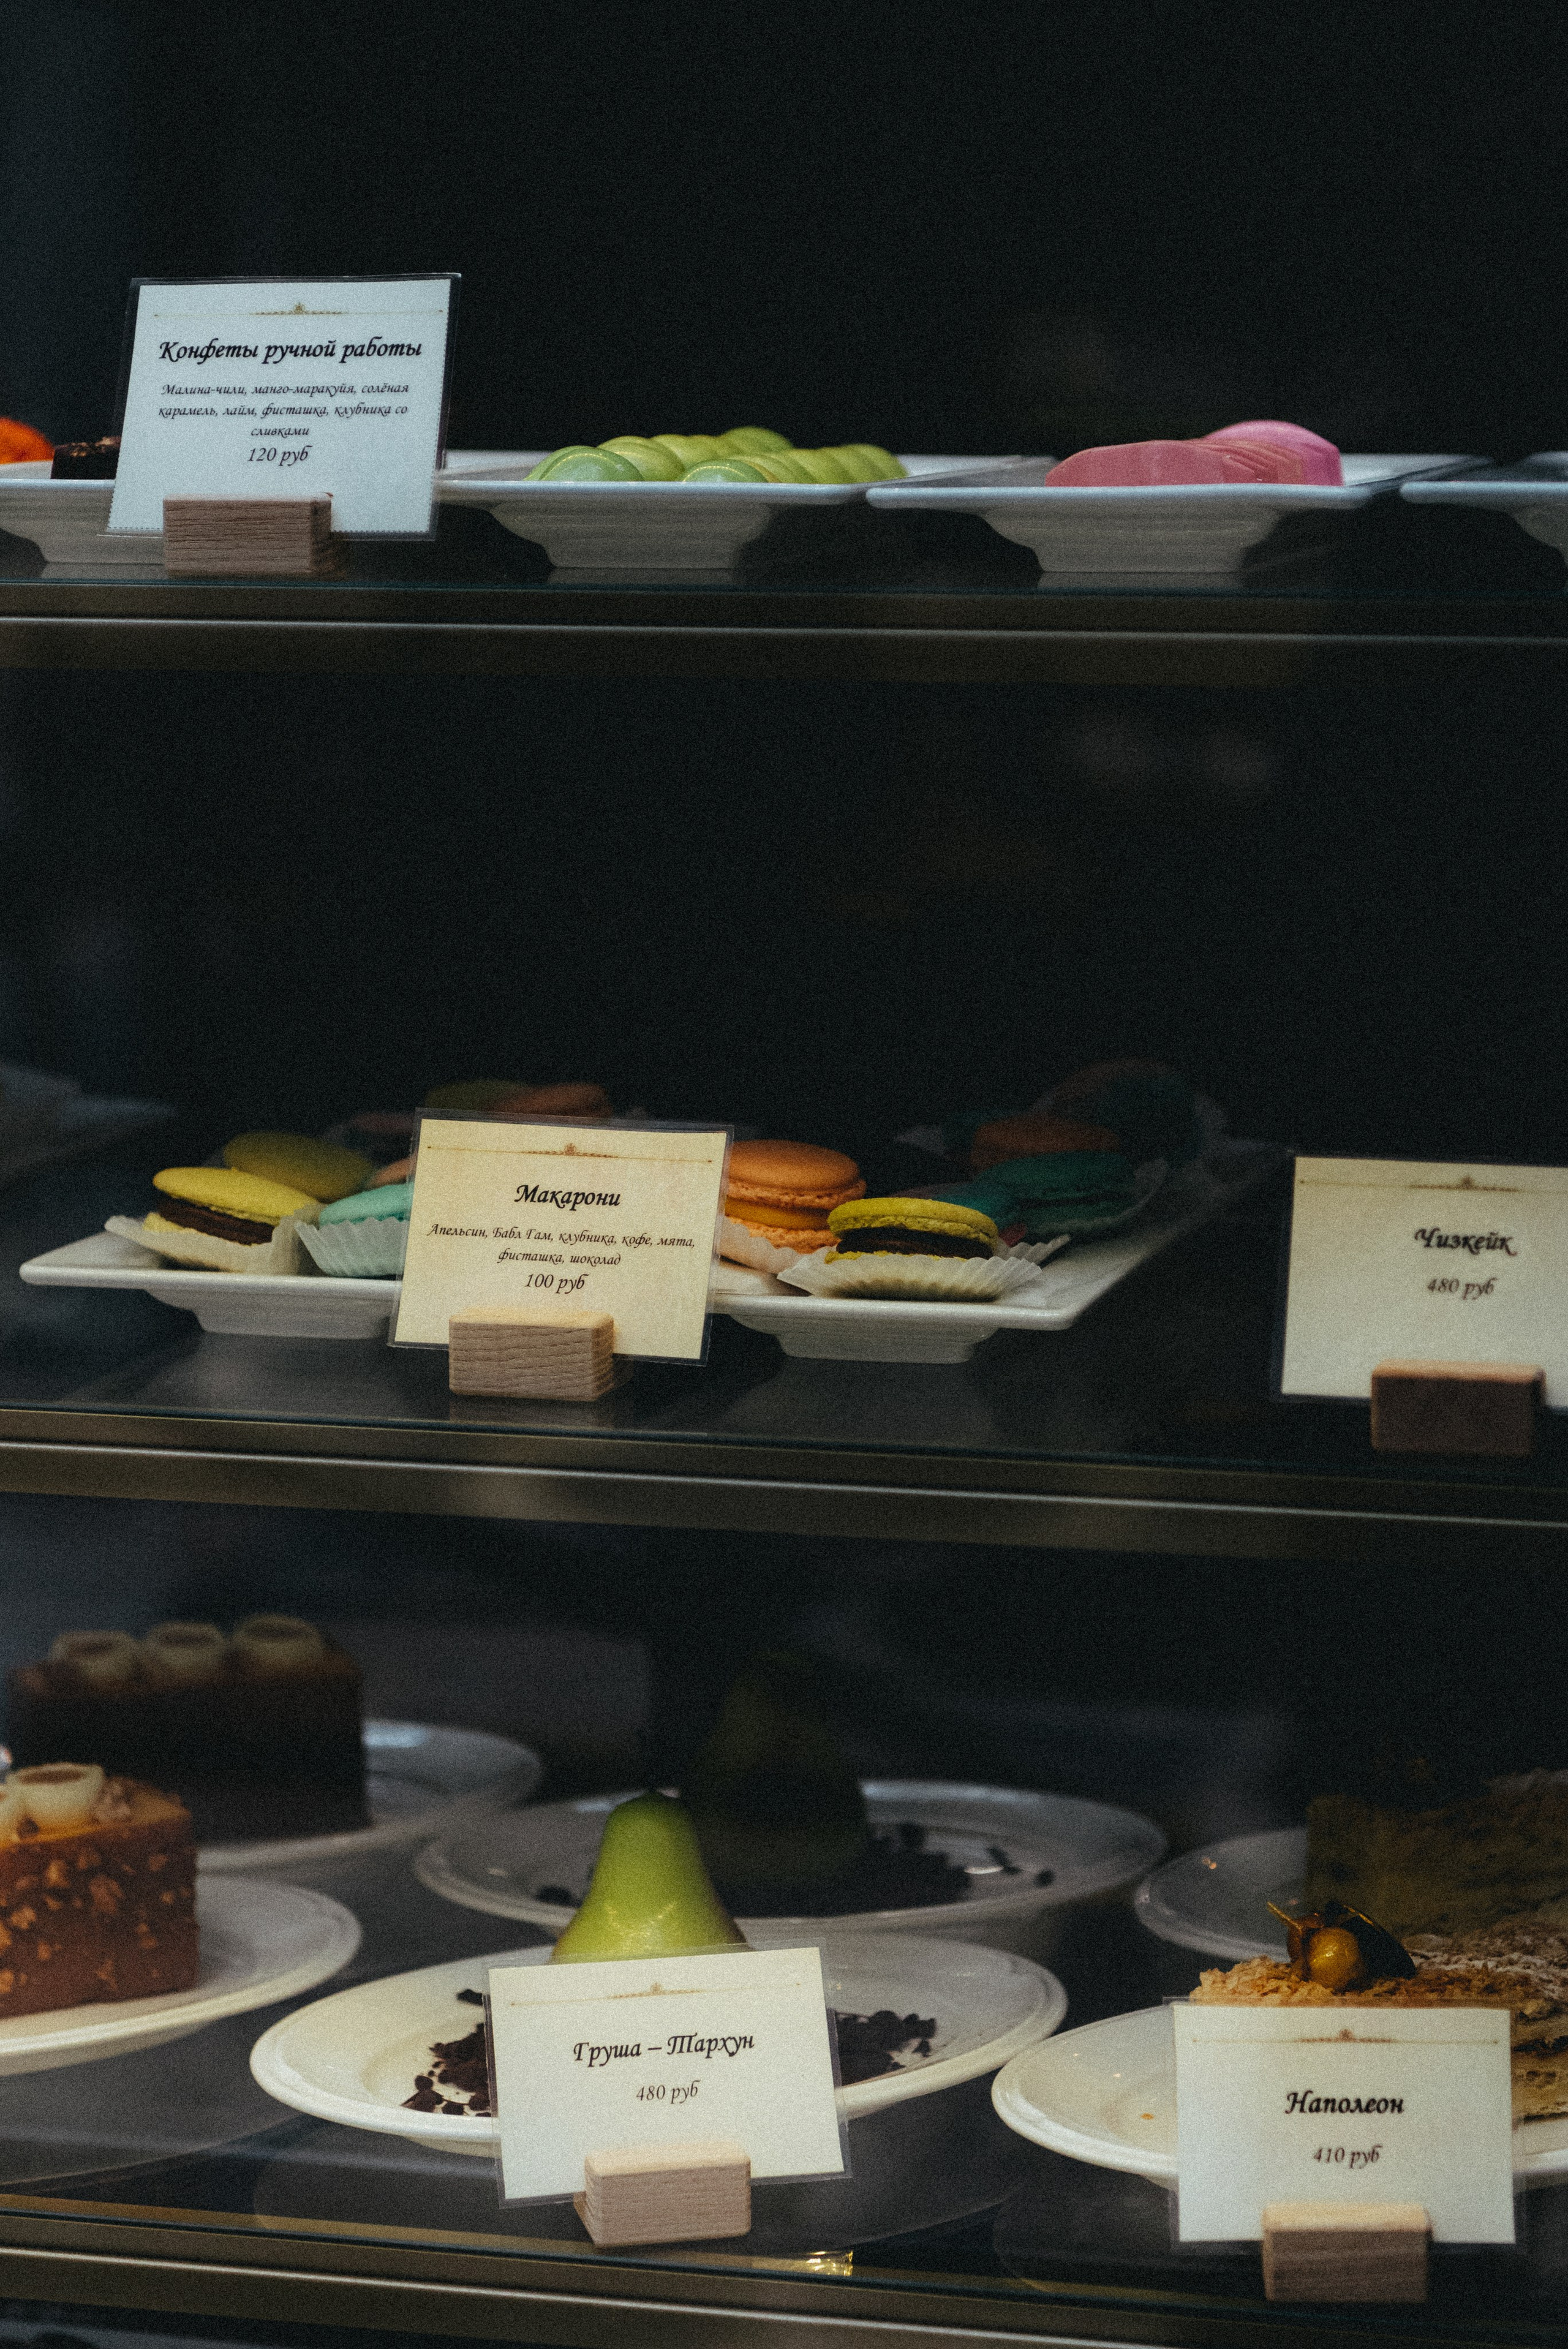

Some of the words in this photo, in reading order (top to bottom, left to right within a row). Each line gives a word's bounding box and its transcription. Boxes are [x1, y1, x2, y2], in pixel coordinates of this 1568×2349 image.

[159, 338, 258, 365] Конфеты
[262, 339, 336, 364] ручной
[339, 336, 422, 364] работы
[161, 383, 247, 396] Малина-чили,
[251, 383, 357, 398] манго-маракуйя,
[361, 383, 409, 394] солёная
[158, 405, 218, 420] карамель,
[223, 404, 258, 417] лайм,
[261, 403, 330, 419] фисташка,
[334, 402, 391, 419] клубника
[394, 406, 408, 415] со
[251, 426, 309, 438] сливками
[247, 446, 277, 462] 120
[279, 445, 313, 467] руб
[514, 1184, 621, 1211] Макарони
[427, 1223, 488, 1239] Апельсин,
[492, 1226, 522, 1239] Бабл
[526, 1228, 554, 1242] Гам,
[559, 1230, 617, 1245] клубника,
[622, 1233, 652, 1249] кофе,
[657, 1236, 696, 1248] мята,
[1414, 1227, 1518, 1256] Чизкейк
[497, 1248, 565, 1264] фисташка,
[569, 1253, 622, 1267] шоколад
[524, 1273, 554, 1289] 100
[556, 1273, 589, 1294] руб
[1427, 1277, 1460, 1294] 480
[1462, 1277, 1498, 1300] руб
[573, 2041, 641, 2068] Груша
[667, 2032, 755, 2060] Тархун
[636, 2084, 666, 2102] 480
[670, 2079, 701, 2105] руб
[1284, 2090, 1405, 2114] Наполеон
[1312, 2146, 1346, 2163] 410
[1349, 2144, 1383, 2169] руб
